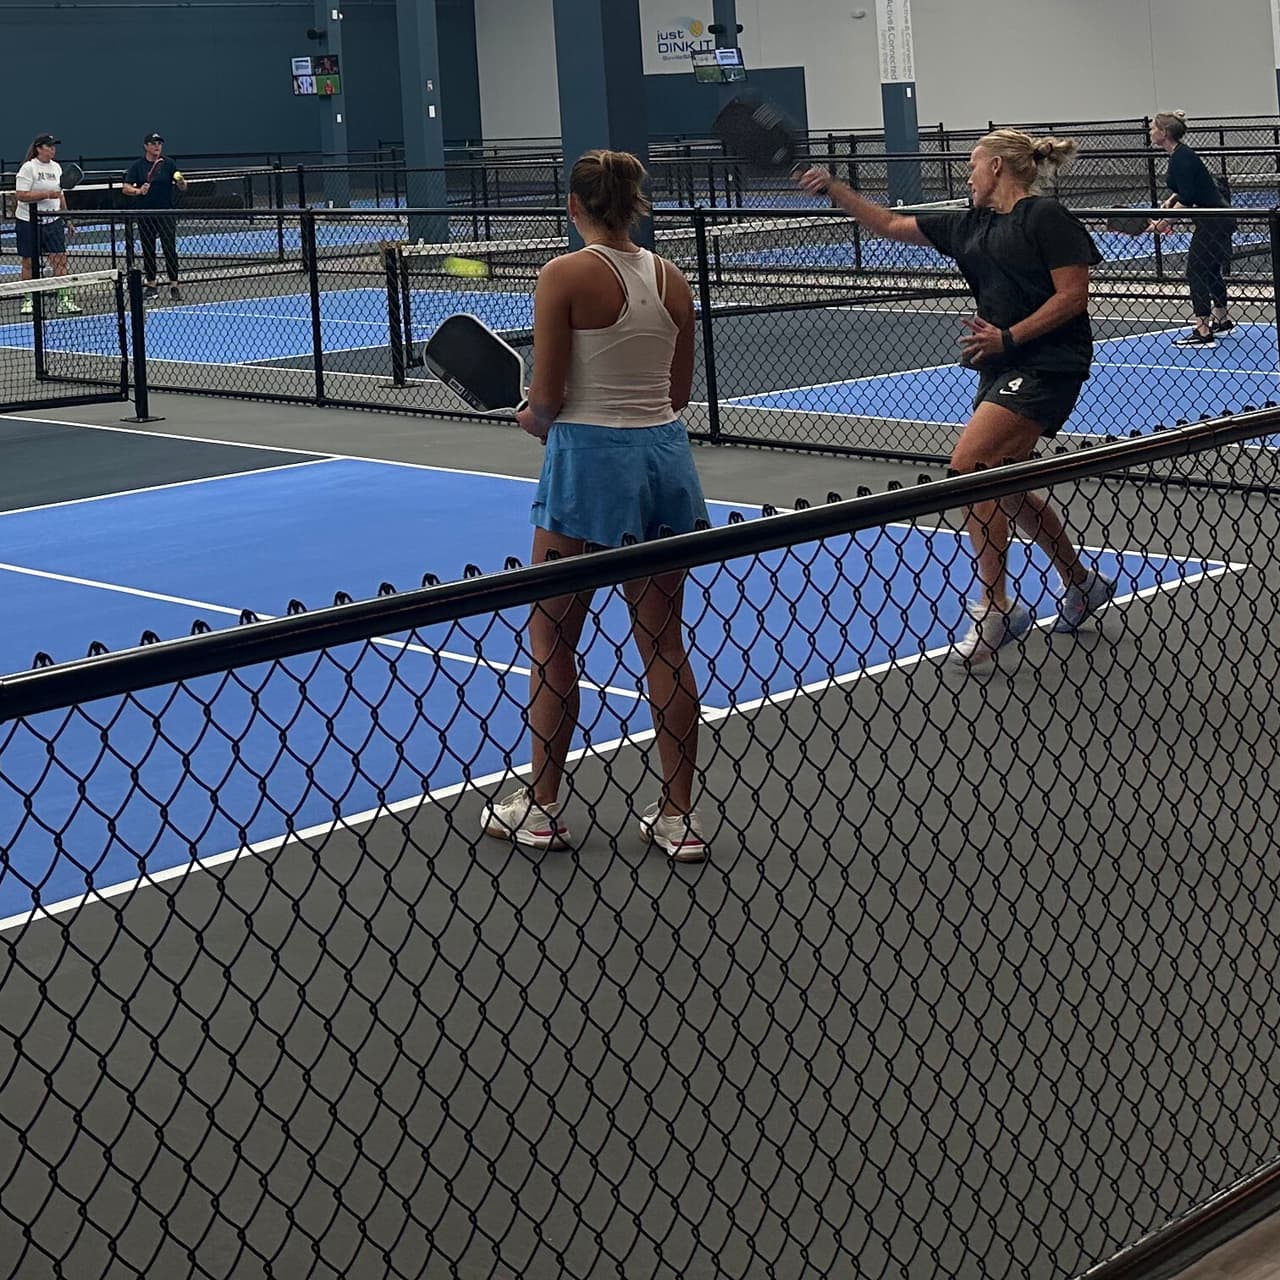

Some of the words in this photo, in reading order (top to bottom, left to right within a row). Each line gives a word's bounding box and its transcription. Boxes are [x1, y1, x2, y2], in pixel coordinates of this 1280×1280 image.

[657, 30, 684, 42] just
[658, 41, 696, 53] DINK
[700, 39, 712, 50] IT
[1008, 377, 1023, 391] 4
